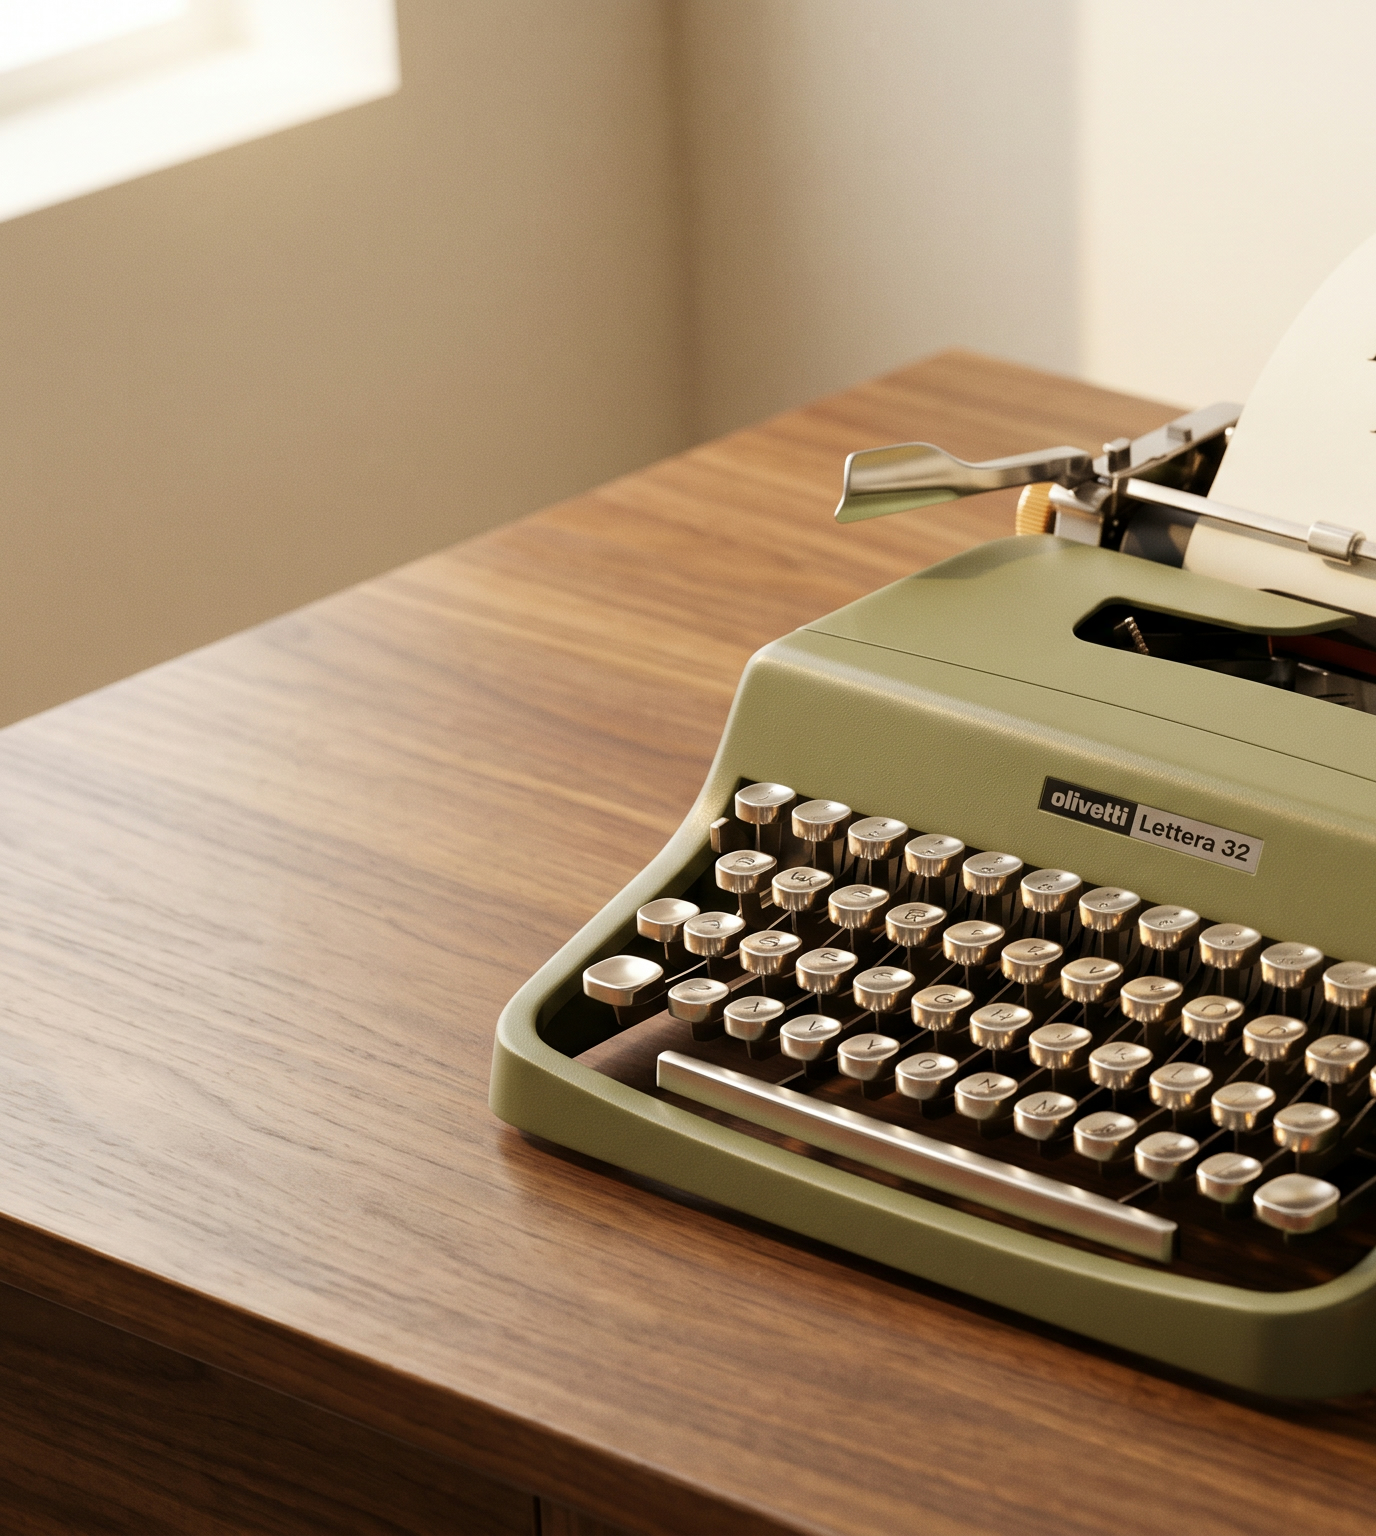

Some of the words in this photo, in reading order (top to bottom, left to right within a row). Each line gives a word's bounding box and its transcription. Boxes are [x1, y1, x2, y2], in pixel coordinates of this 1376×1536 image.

[1050, 789, 1130, 827] olivetti
[1138, 814, 1216, 853] Lettera
[1221, 839, 1251, 863] 32
[933, 993, 956, 1004] G
